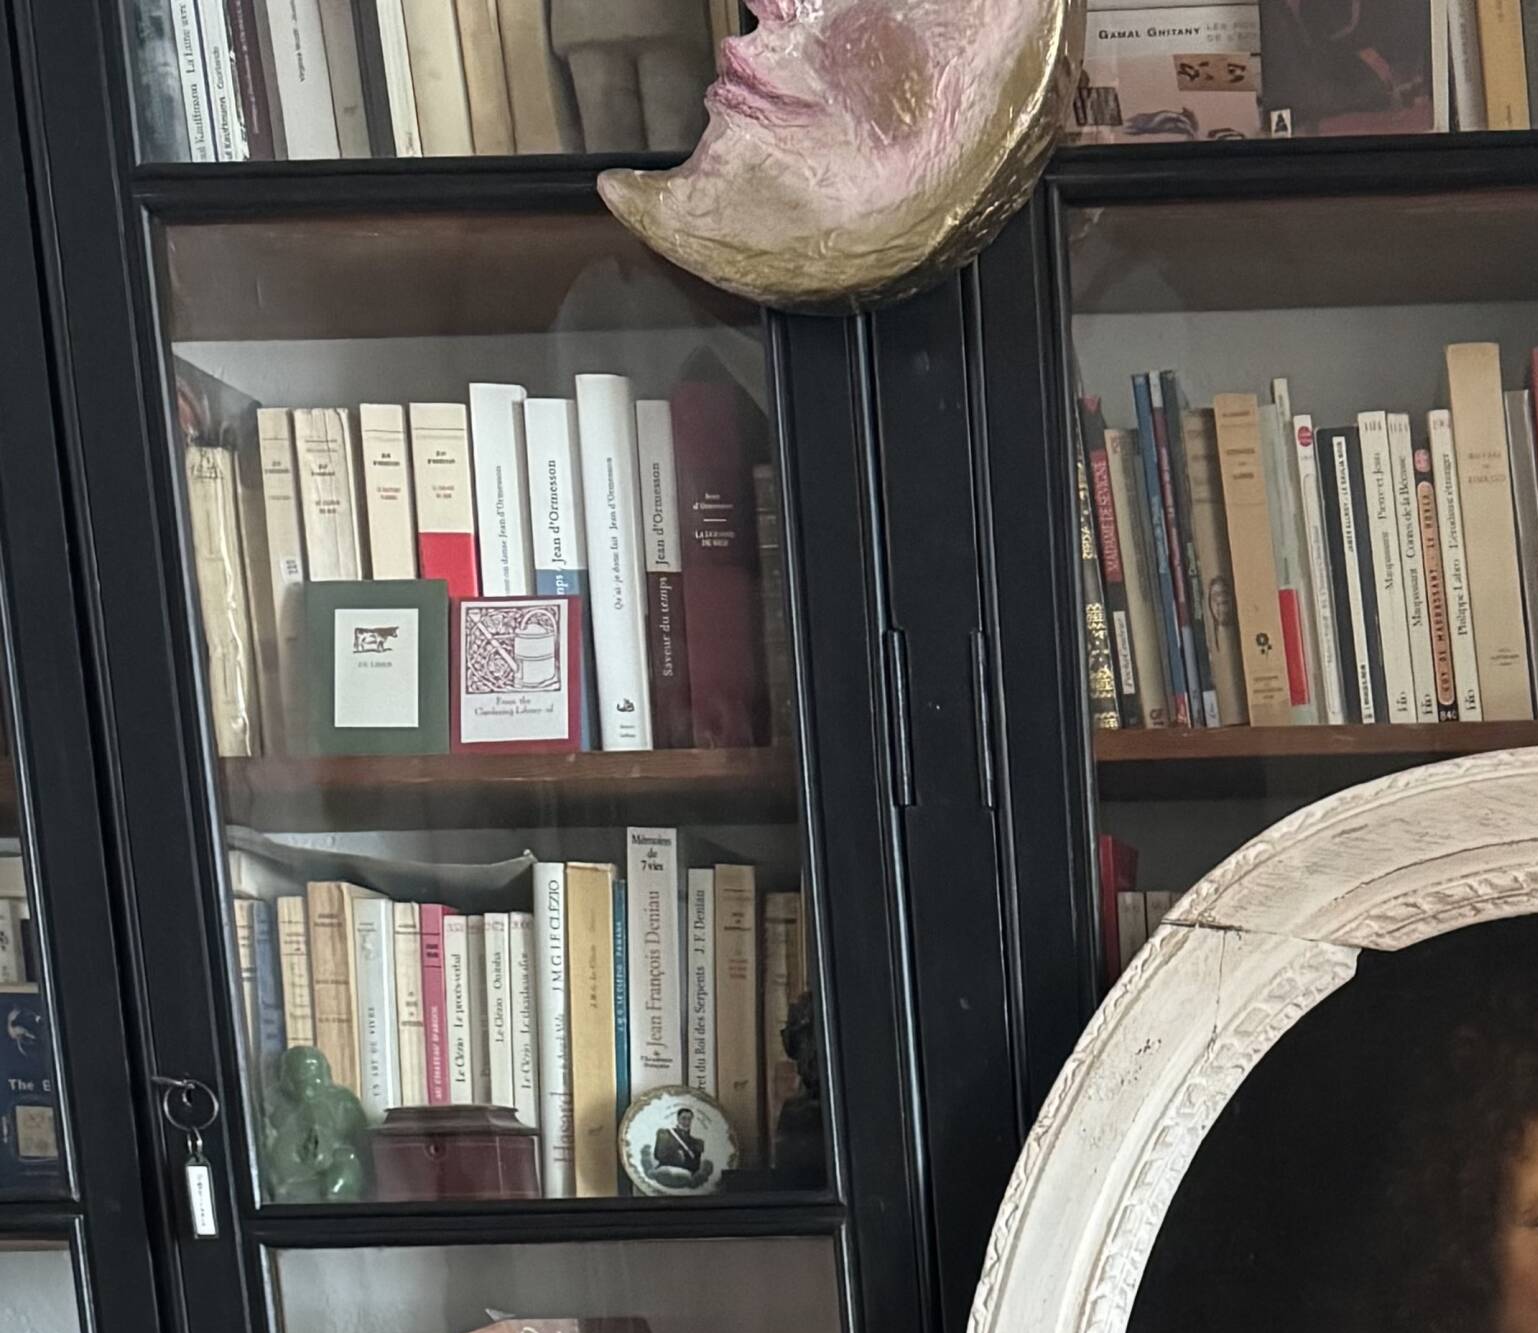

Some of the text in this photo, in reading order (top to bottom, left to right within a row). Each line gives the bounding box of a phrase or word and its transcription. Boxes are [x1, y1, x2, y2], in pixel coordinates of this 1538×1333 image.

[1372, 452, 1385, 476] Jean
[1397, 456, 1411, 497] Bécasse
[1442, 453, 1456, 494] étranger
[494, 465, 506, 519] d'Ormesson
[605, 457, 616, 509] d'Ormesson
[546, 459, 566, 565] Jean d'Ormesson
[1375, 488, 1388, 519] Pierre
[1401, 507, 1412, 521] de
[497, 519, 508, 539] Jean
[608, 509, 618, 530] Jean
[1101, 506, 1119, 572] MADAME DE
[1403, 522, 1420, 558] Contes
[650, 461, 674, 677] Saveur du temps Jean d'Ormesson
[1380, 531, 1395, 590] Maupassant
[1450, 558, 1464, 590] Labro
[1407, 567, 1422, 627] Maupassant
[1429, 568, 1445, 641] MAUPASSANT
[1451, 591, 1468, 635] Philippe
[641, 859, 664, 871] 7 vies
[647, 848, 658, 858] de
[548, 880, 560, 930] CLÉZIO
[695, 890, 705, 930] Deniau
[551, 955, 561, 967] G
[552, 970, 563, 983] M
[644, 890, 668, 1049] Jean François Deniau
[695, 966, 708, 1014] Serpents
[452, 1016, 464, 1028] Le
[494, 997, 504, 1029] Clézio
[695, 1016, 706, 1033] des
[495, 1029, 504, 1042] Le
[696, 1035, 706, 1055] Roi
[454, 1037, 465, 1067] Clézio
[520, 1043, 531, 1073] Clézio
[696, 1057, 707, 1072] du
[8, 1078, 35, 1091] The
[455, 1068, 466, 1082] Le
[521, 1075, 532, 1088] Le
[552, 1091, 573, 1163] Hasard
